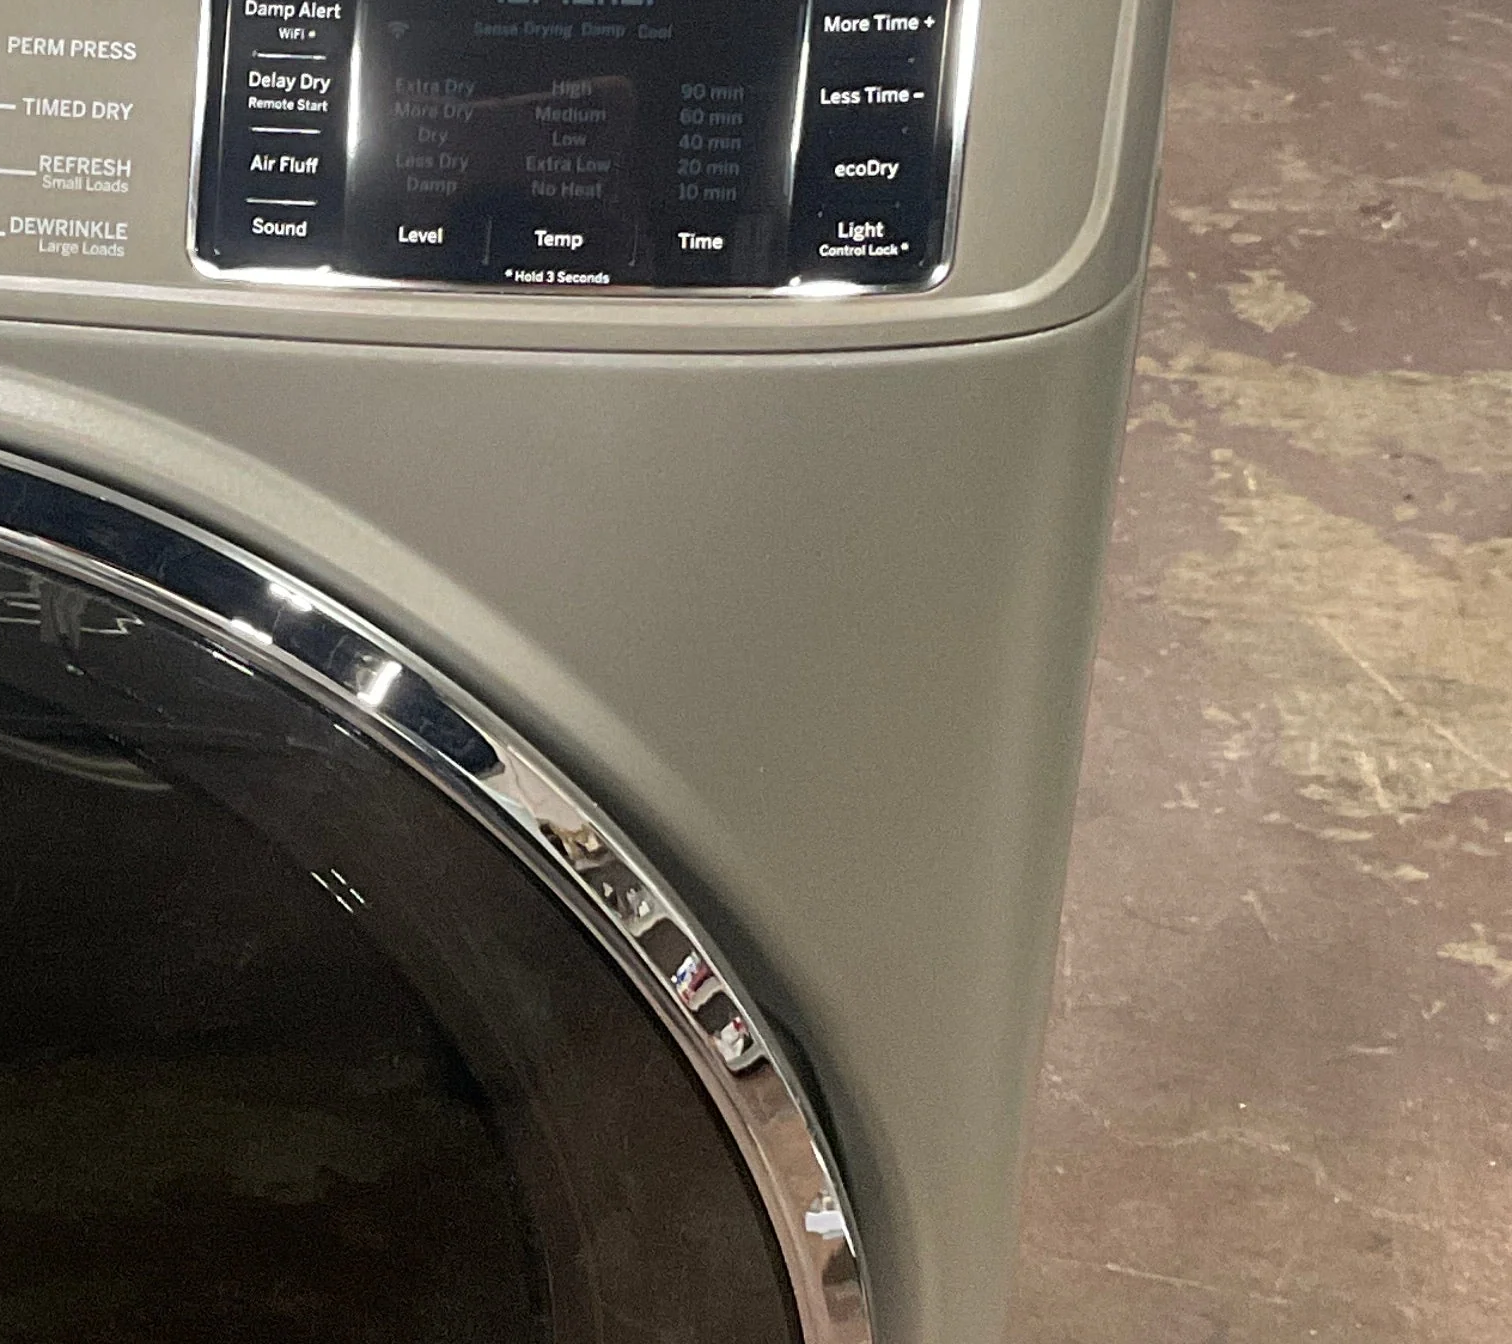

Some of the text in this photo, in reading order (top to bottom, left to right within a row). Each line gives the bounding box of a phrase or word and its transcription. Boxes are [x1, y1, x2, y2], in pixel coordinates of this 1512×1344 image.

[245, 0, 341, 21] Damp Alert
[823, 15, 870, 32] More
[873, 13, 919, 31] Time
[279, 27, 305, 40] WiFi
[7, 36, 137, 60] PERM PRESS
[248, 71, 331, 94] Delay Dry
[248, 96, 328, 112] Remote Start
[820, 88, 861, 105] Less
[864, 86, 910, 104] Time
[22, 97, 134, 121] TIMED DRY
[708, 109, 744, 126] min
[418, 126, 449, 147] Dry
[552, 129, 588, 147] Low
[39, 154, 132, 178] REFRESH
[250, 154, 320, 174] Air Fluff
[706, 160, 740, 177] min
[834, 159, 899, 179] ecoDry
[42, 176, 128, 193] Small Loads
[531, 179, 558, 197] No
[703, 184, 737, 202] min
[10, 216, 128, 240] DEWRINKLE
[251, 217, 308, 237] Sound
[398, 226, 443, 244] Level
[838, 221, 884, 242] Light
[39, 239, 125, 257] Large Loads
[534, 229, 584, 250] Temp
[677, 231, 725, 250] Time
[819, 243, 899, 257] Control Lock
[514, 270, 610, 285] Hold 3 Seconds
